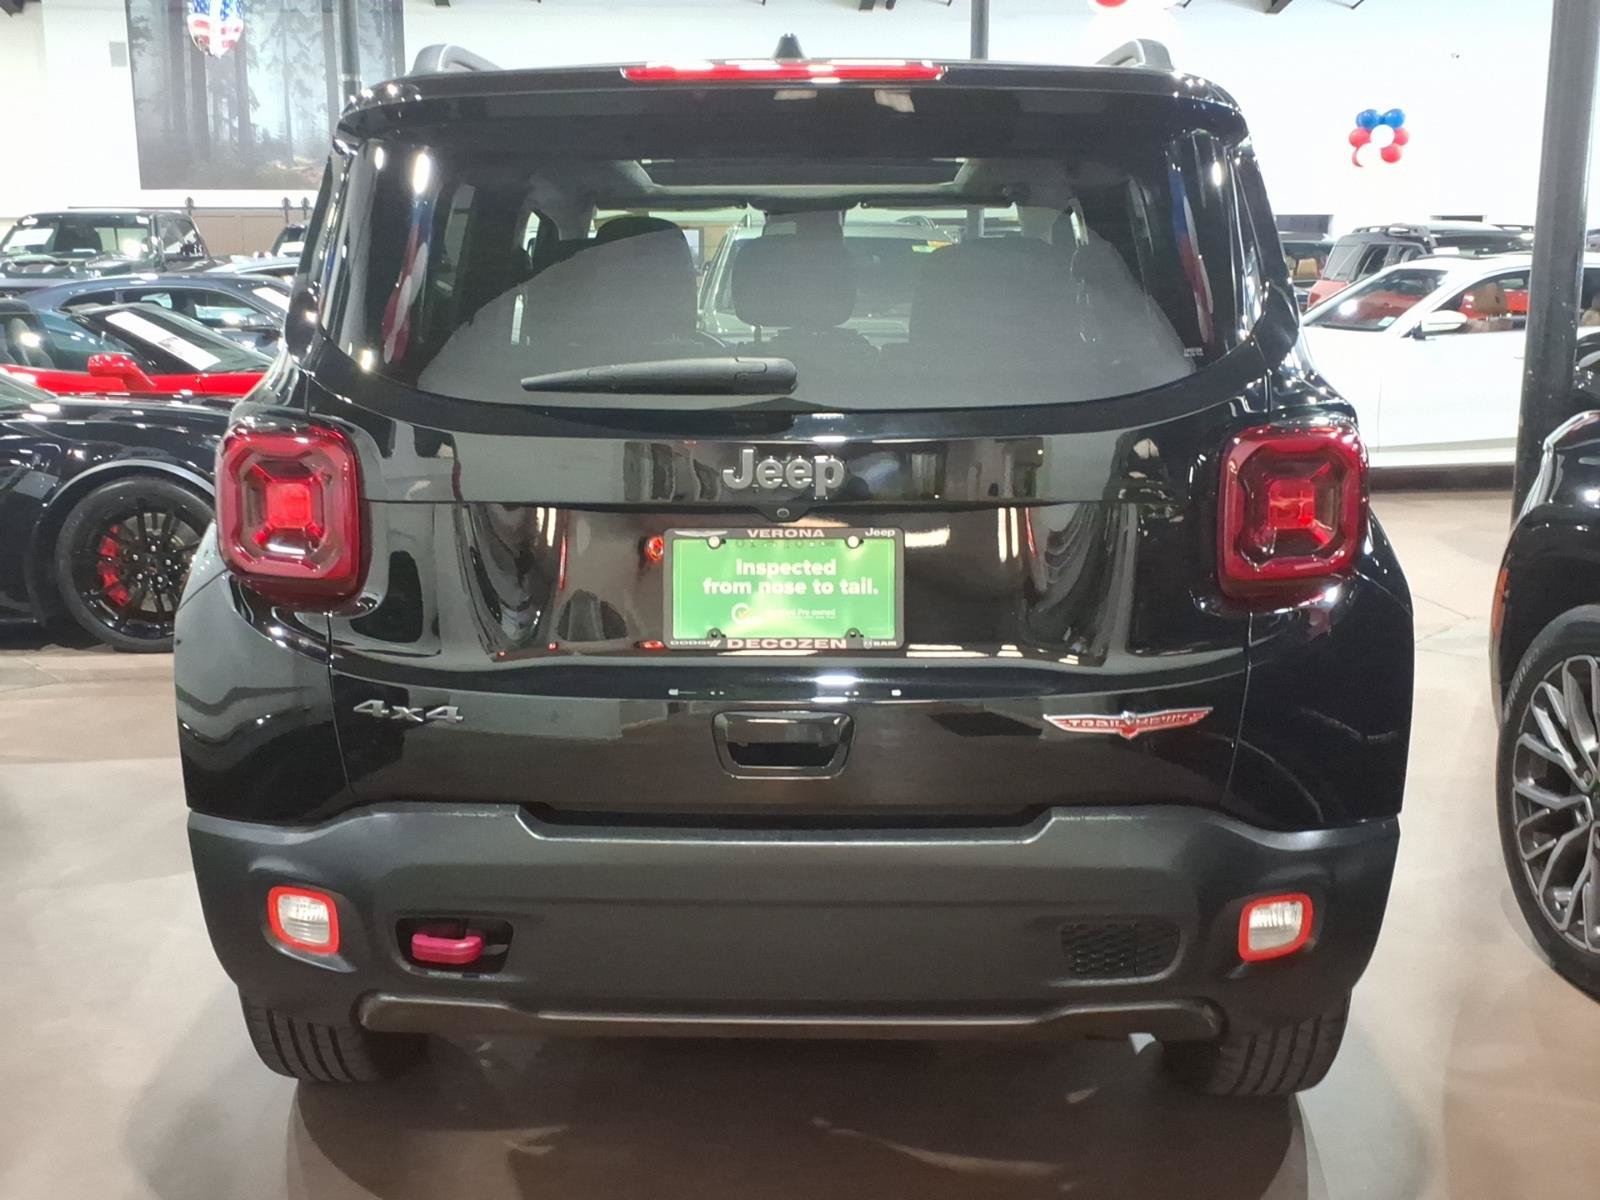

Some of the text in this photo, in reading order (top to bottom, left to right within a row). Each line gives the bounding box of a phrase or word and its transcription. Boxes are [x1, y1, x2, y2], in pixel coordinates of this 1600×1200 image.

[722, 449, 845, 499] Jeep
[747, 528, 825, 538] VERONA
[865, 527, 895, 537] Jeep
[736, 558, 836, 580] Inspected
[703, 577, 879, 595] from nose to tail.
[726, 639, 847, 649] DECOZEN
